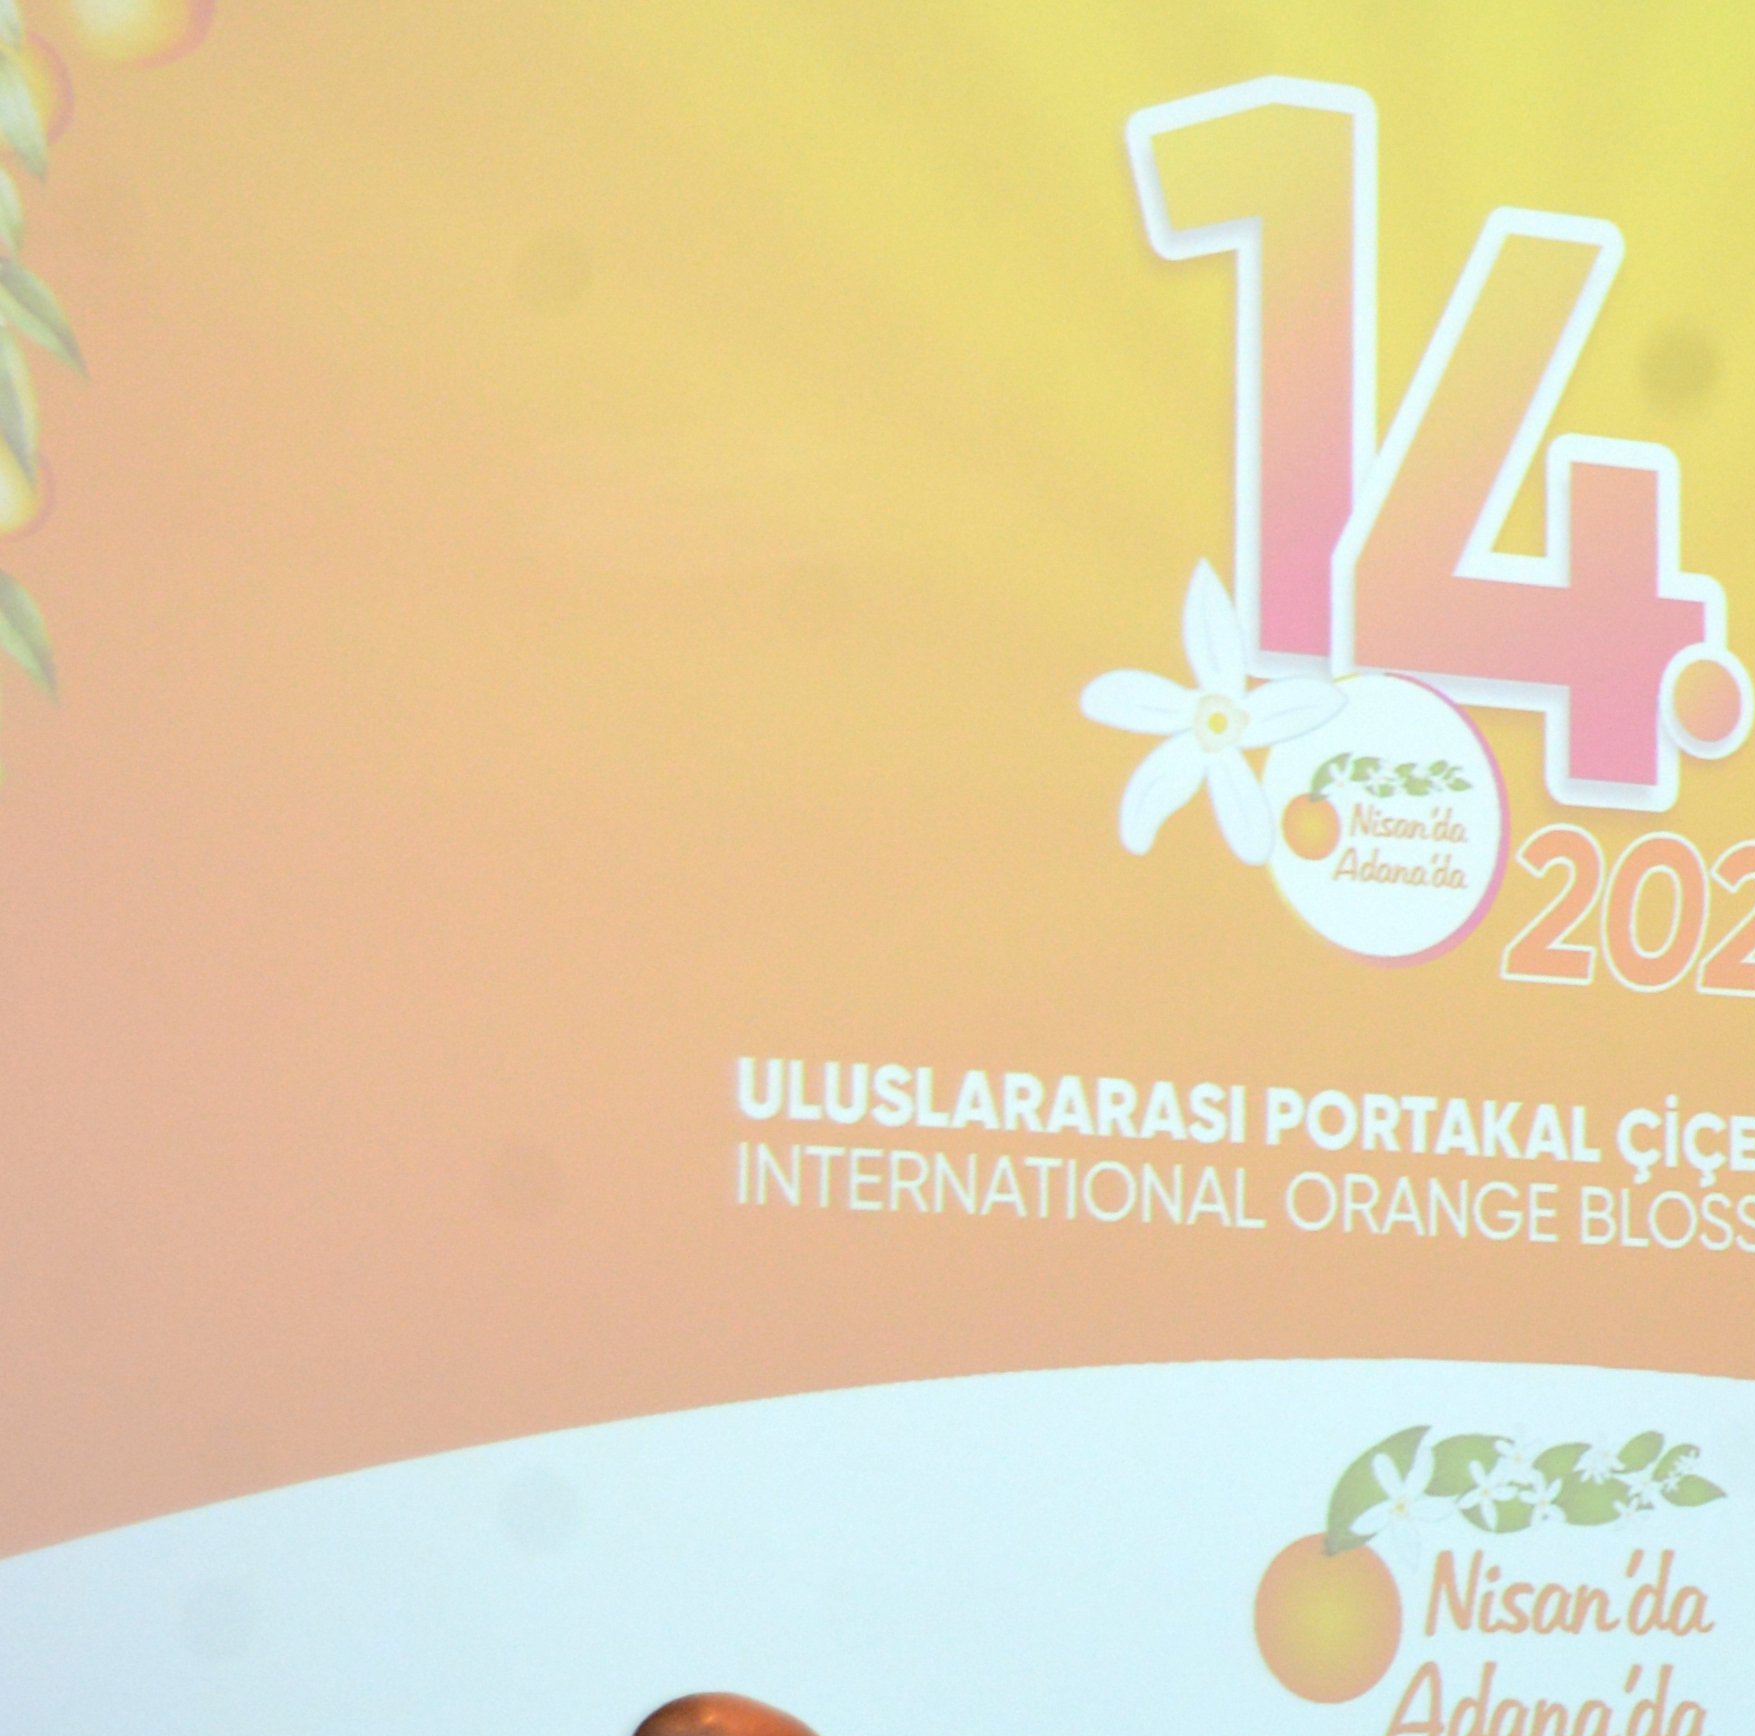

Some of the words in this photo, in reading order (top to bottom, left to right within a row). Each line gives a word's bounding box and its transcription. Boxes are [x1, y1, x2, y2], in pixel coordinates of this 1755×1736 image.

[1350, 803, 1468, 843] Nisan'da
[1332, 847, 1468, 889] Adana'da
[736, 1055, 1247, 1144] ULUSLARARASI
[1265, 1086, 1602, 1164] PORTAKAL
[737, 1141, 1267, 1230] INTERNATIONAL
[1285, 1170, 1559, 1244] ORANGE
[1424, 1548, 1716, 1637] Nisan'da
